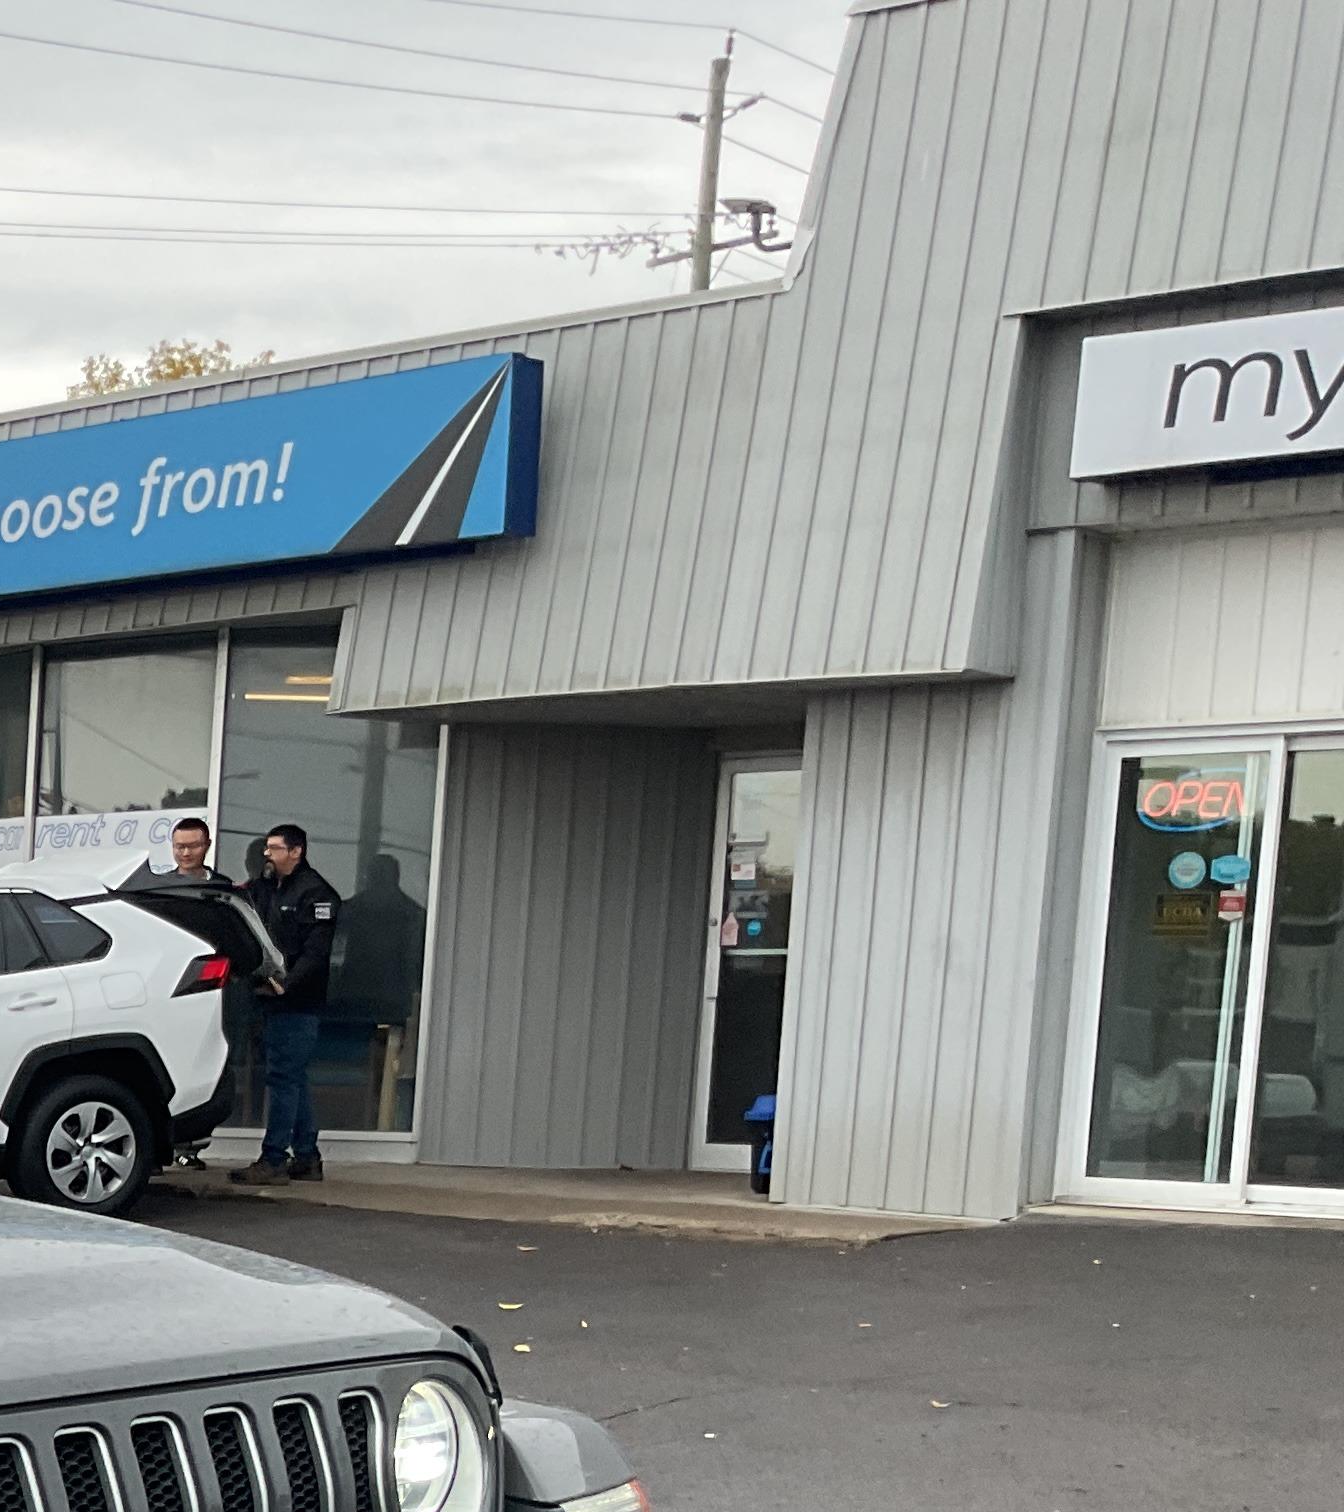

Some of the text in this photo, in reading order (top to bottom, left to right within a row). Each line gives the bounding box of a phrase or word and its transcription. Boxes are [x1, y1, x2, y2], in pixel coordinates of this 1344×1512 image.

[131, 442, 294, 537] from!
[1144, 780, 1248, 818] OPEN
[35, 813, 106, 848] rent
[114, 819, 138, 846] a
